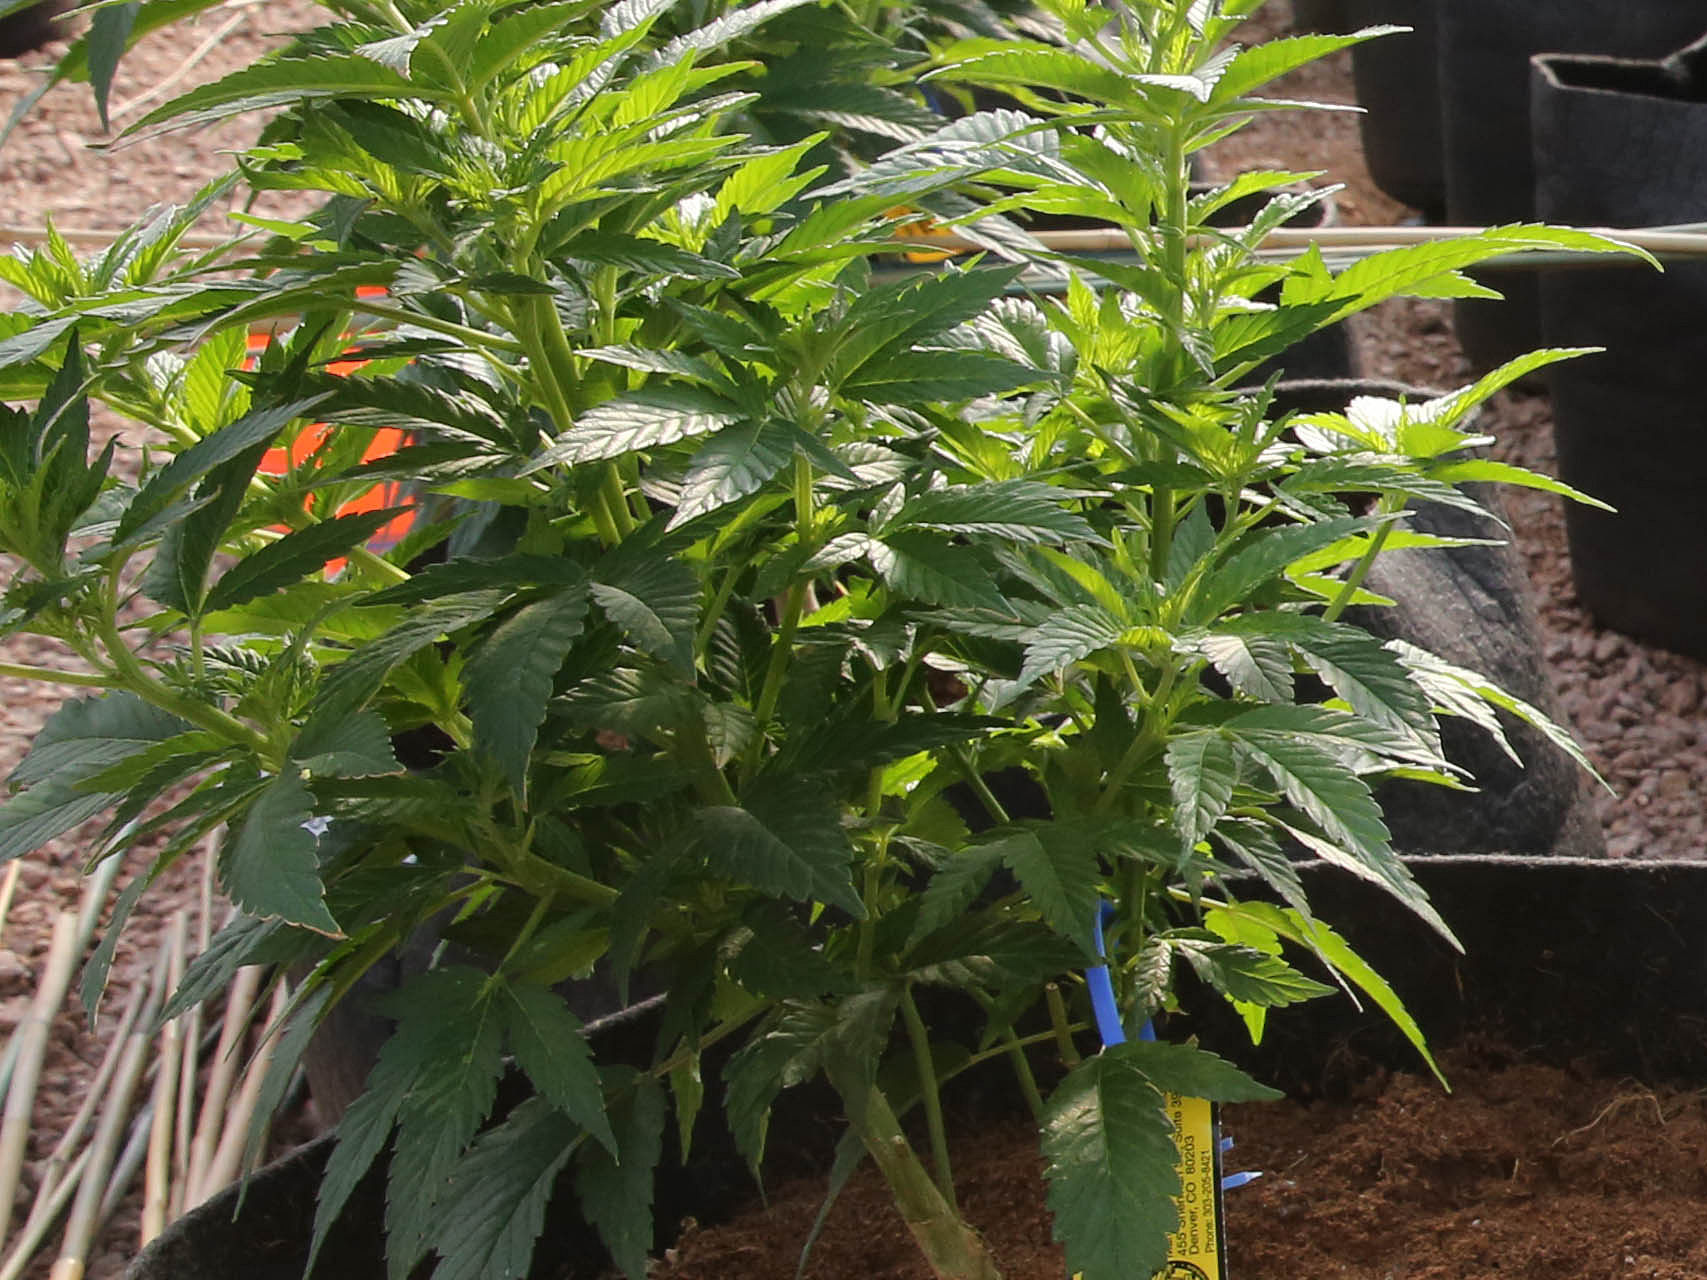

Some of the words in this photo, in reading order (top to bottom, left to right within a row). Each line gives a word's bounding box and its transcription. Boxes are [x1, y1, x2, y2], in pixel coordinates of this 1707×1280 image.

[1184, 1135, 1196, 1175] 80203
[1186, 1181, 1198, 1204] CO
[1176, 1231, 1187, 1257] 455
[1188, 1207, 1200, 1255] Denver,
